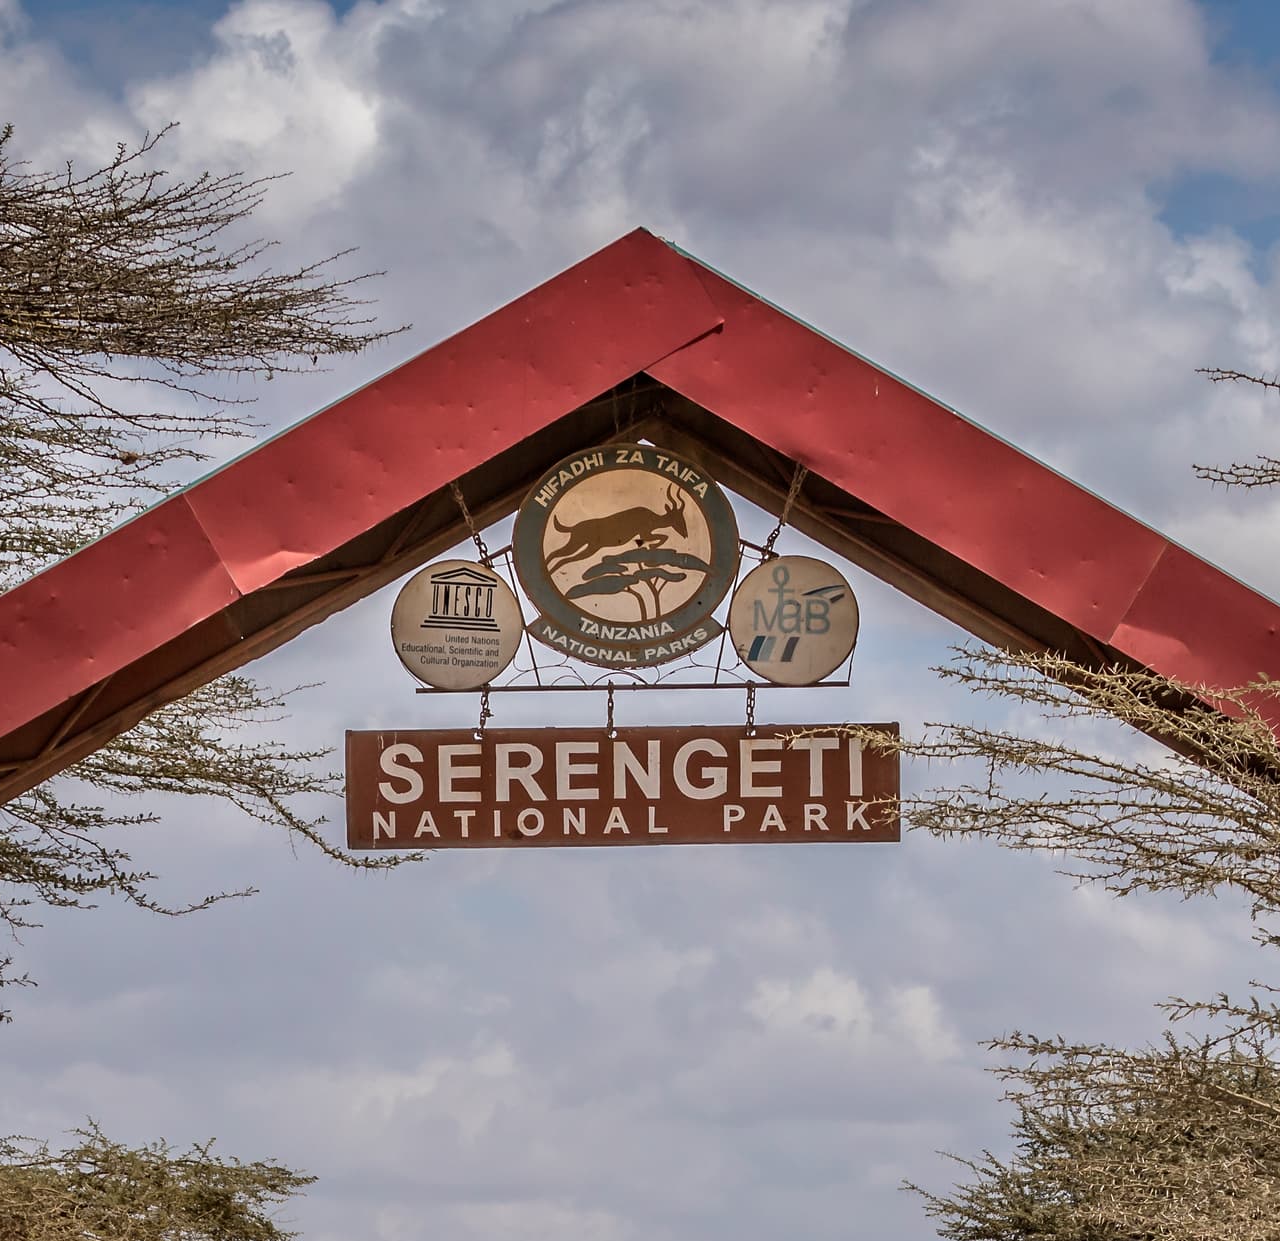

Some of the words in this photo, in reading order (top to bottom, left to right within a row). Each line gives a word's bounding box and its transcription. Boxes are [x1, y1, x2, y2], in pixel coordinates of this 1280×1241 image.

[615, 450, 644, 465] ZA
[656, 455, 709, 499] TAIFA
[432, 584, 493, 618] UNESCO
[445, 634, 470, 644] United
[471, 636, 500, 646] Nations
[542, 625, 637, 662] NATIONAL
[644, 627, 708, 660] PARKS
[580, 617, 676, 641] TANZANIA
[401, 642, 446, 655] Educational,
[449, 646, 484, 656] Scientific
[485, 648, 499, 657] and
[420, 655, 450, 666] Cultural
[451, 657, 499, 668] Organization
[377, 736, 864, 804] SERENGETI
[372, 807, 669, 840] NATIONAL
[723, 802, 872, 833] PARK
